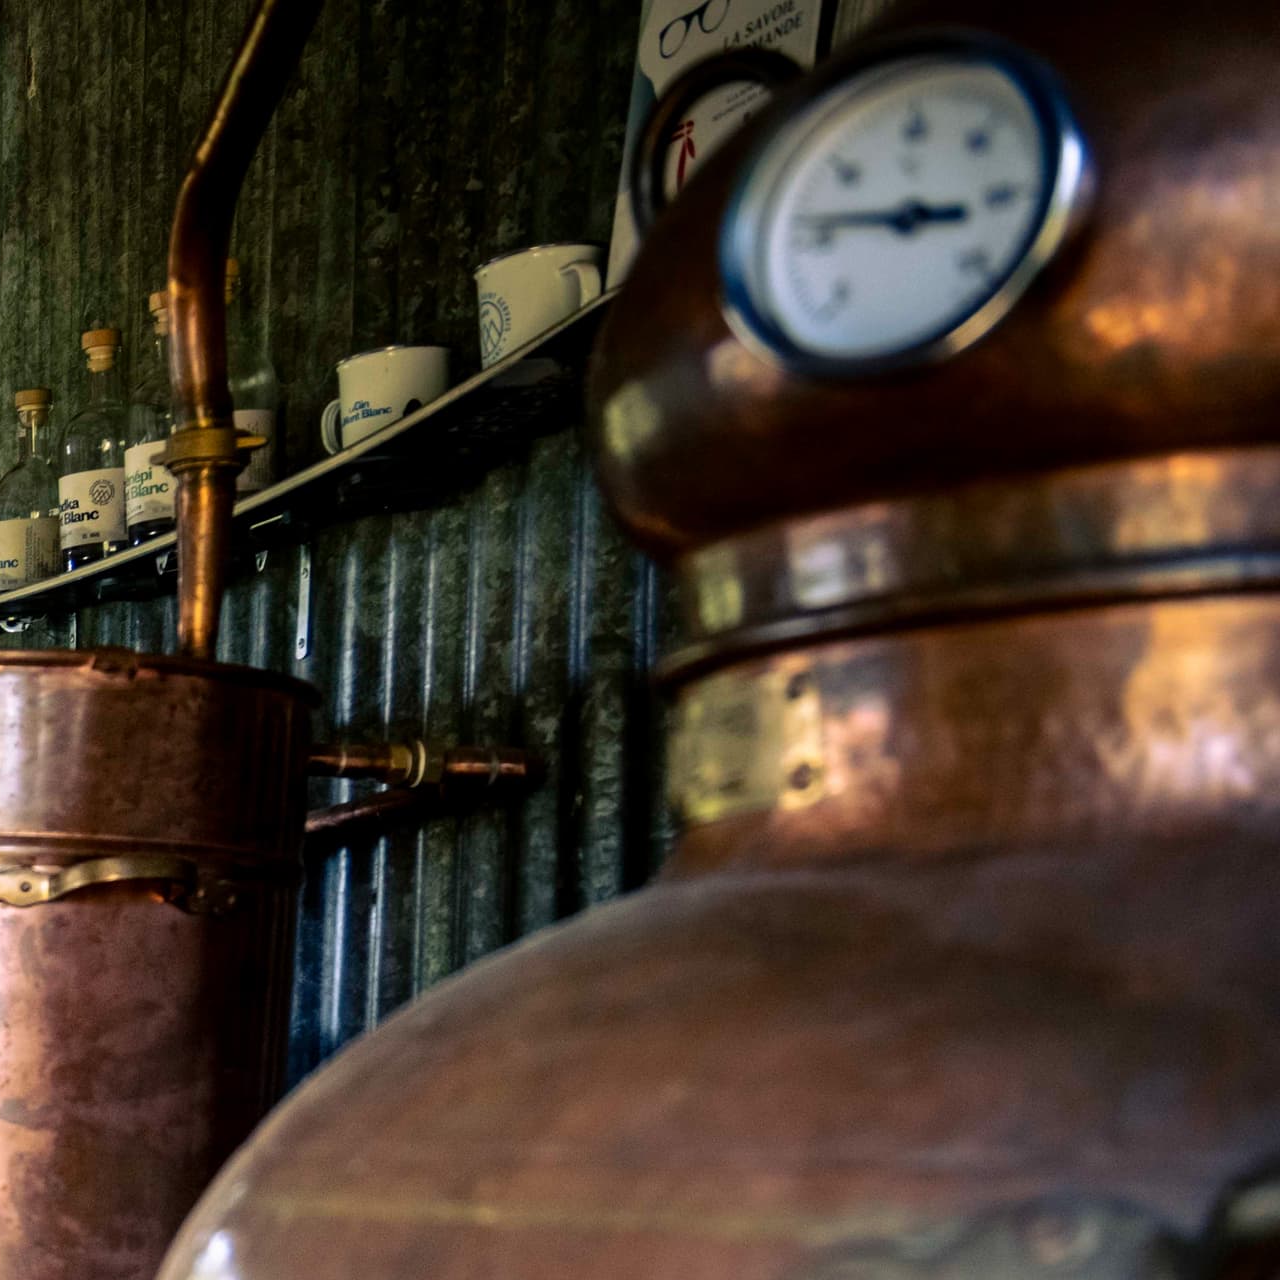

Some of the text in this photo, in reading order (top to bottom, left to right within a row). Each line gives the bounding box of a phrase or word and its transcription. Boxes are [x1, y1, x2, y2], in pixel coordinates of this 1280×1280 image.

[744, 0, 795, 39] SAVOIE
[125, 466, 153, 485] népi
[130, 482, 170, 499] Blanc
[64, 510, 100, 525] Blanc
